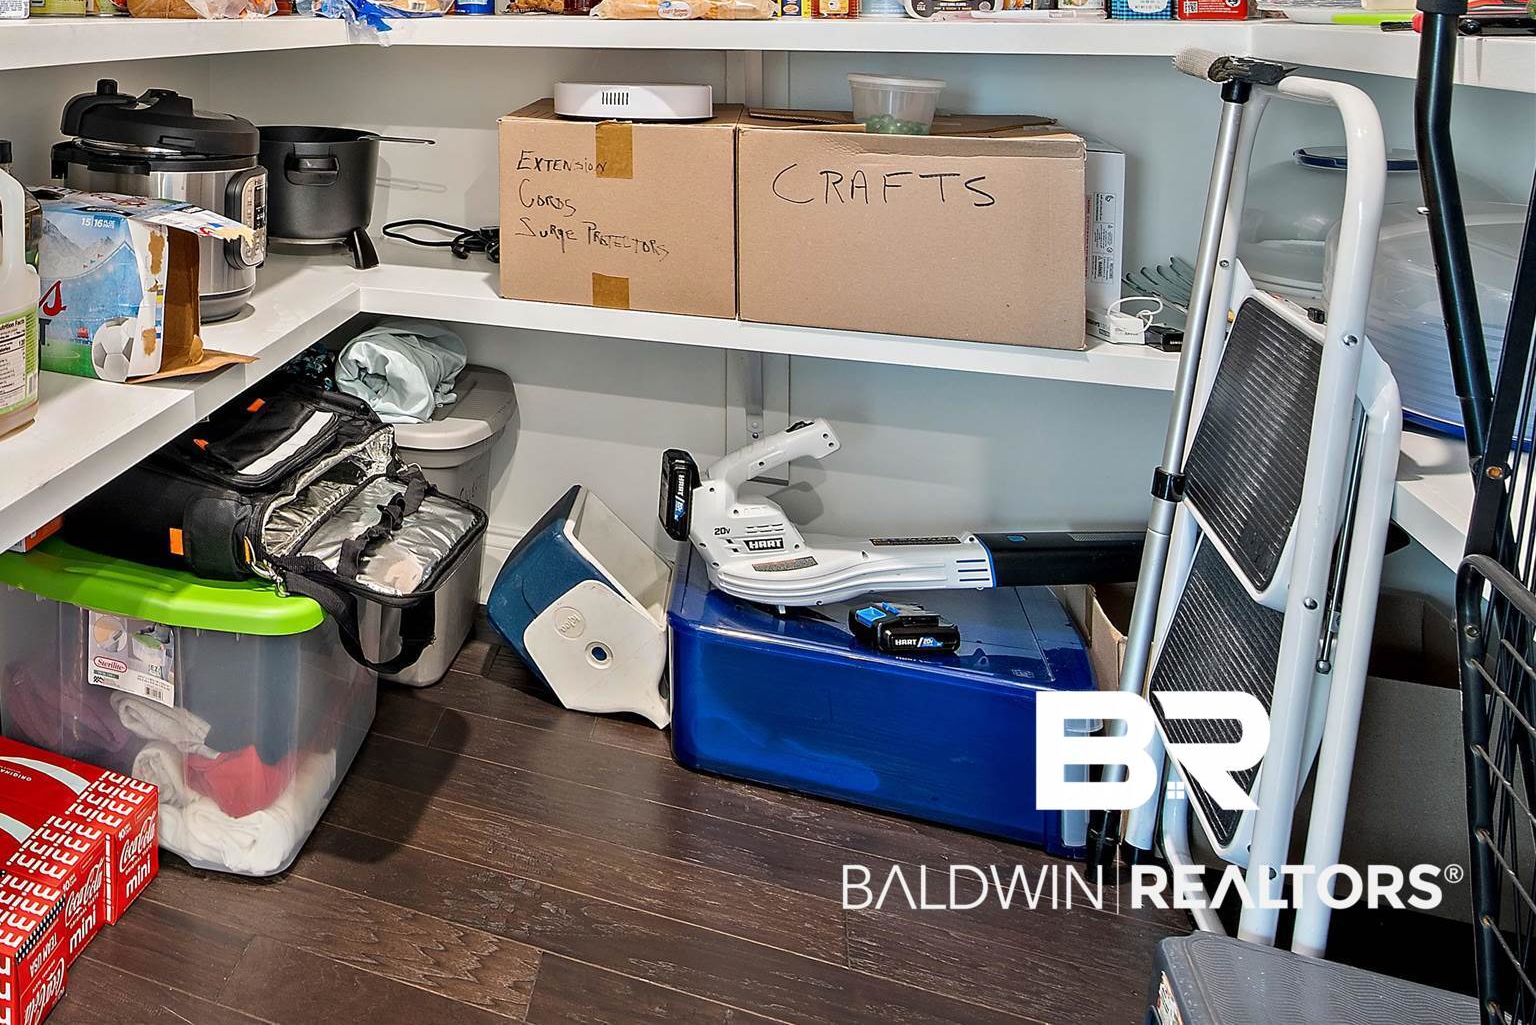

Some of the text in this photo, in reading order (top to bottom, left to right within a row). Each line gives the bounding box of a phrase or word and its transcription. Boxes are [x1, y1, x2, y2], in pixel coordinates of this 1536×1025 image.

[518, 178, 577, 218] CORDS
[771, 162, 997, 207] CRAFTS
[581, 221, 671, 263] PROTECTORS
[748, 539, 783, 550] HART
[95, 656, 128, 673] Sterilite
[88, 780, 145, 805] mini
[100, 770, 155, 795] mini
[65, 802, 124, 828] mini
[77, 791, 134, 816] mini
[32, 827, 91, 853] mini
[43, 815, 102, 841] mini
[20, 839, 80, 867] mini
[120, 811, 157, 874] Coca-Cola
[6, 851, 68, 881] mini
[125, 856, 151, 898] mini
[65, 858, 104, 926] Coca-Cola
[69, 905, 97, 954] mini
